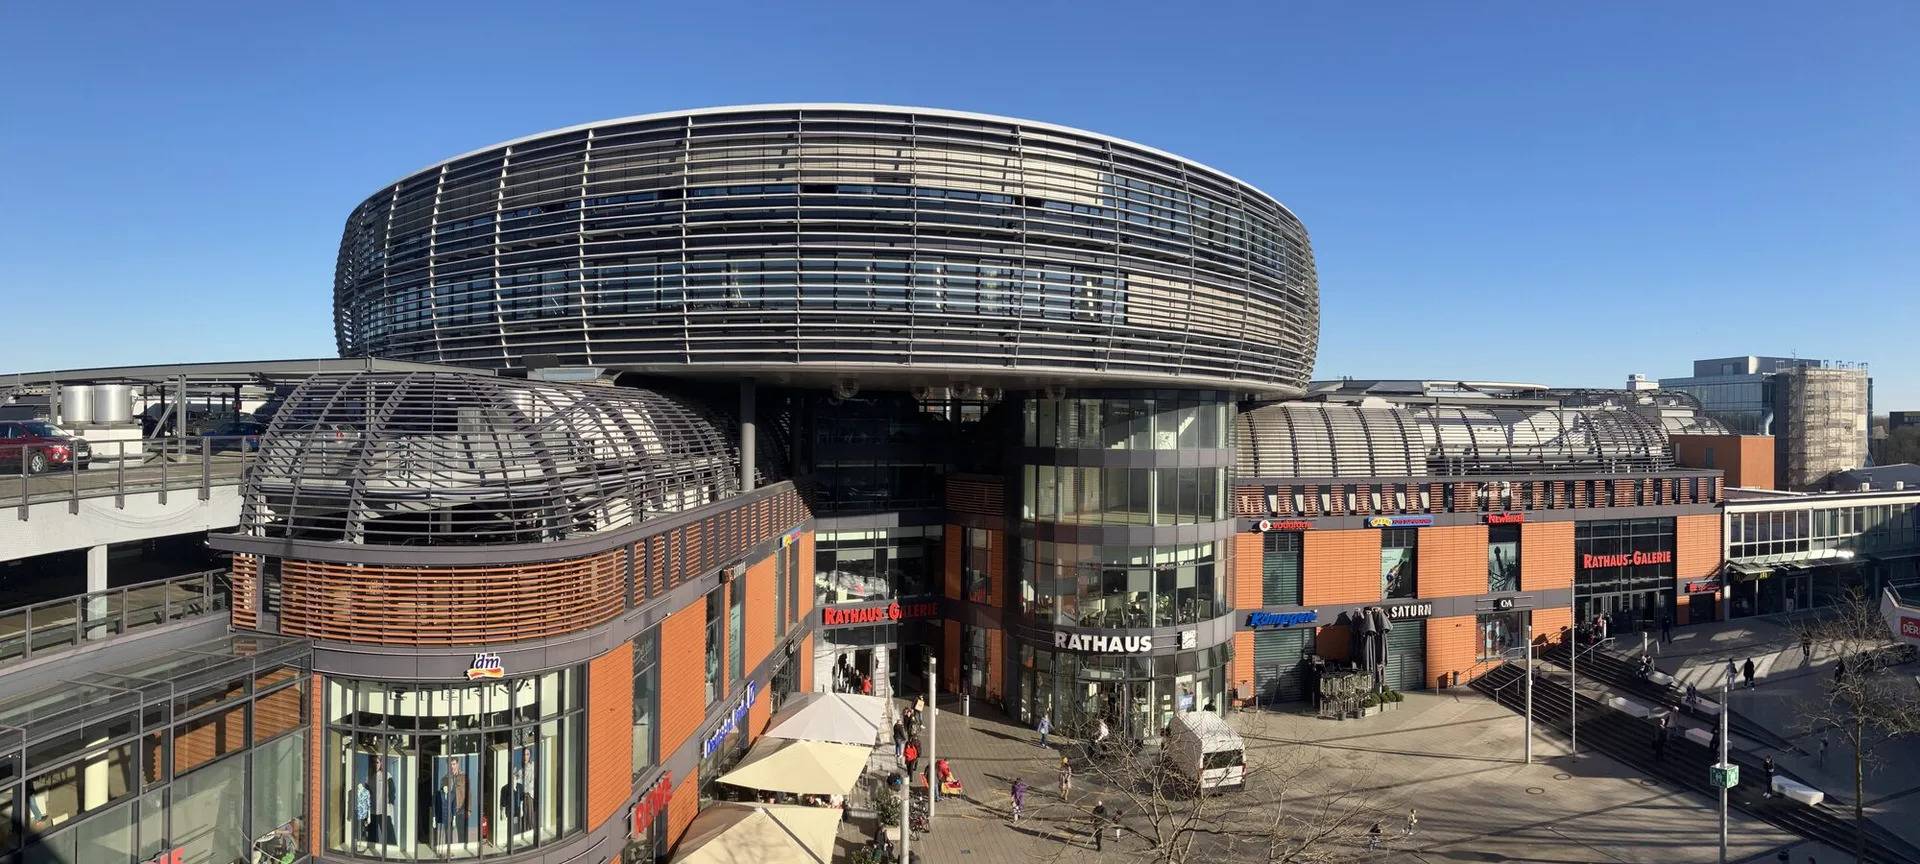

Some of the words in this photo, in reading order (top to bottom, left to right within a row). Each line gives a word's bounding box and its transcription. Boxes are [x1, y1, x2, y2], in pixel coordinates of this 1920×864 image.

[1391, 604, 1432, 618] SATURN
[1054, 631, 1153, 653] RATHAUS
[473, 653, 501, 669] dm
[633, 770, 672, 834] REWE
